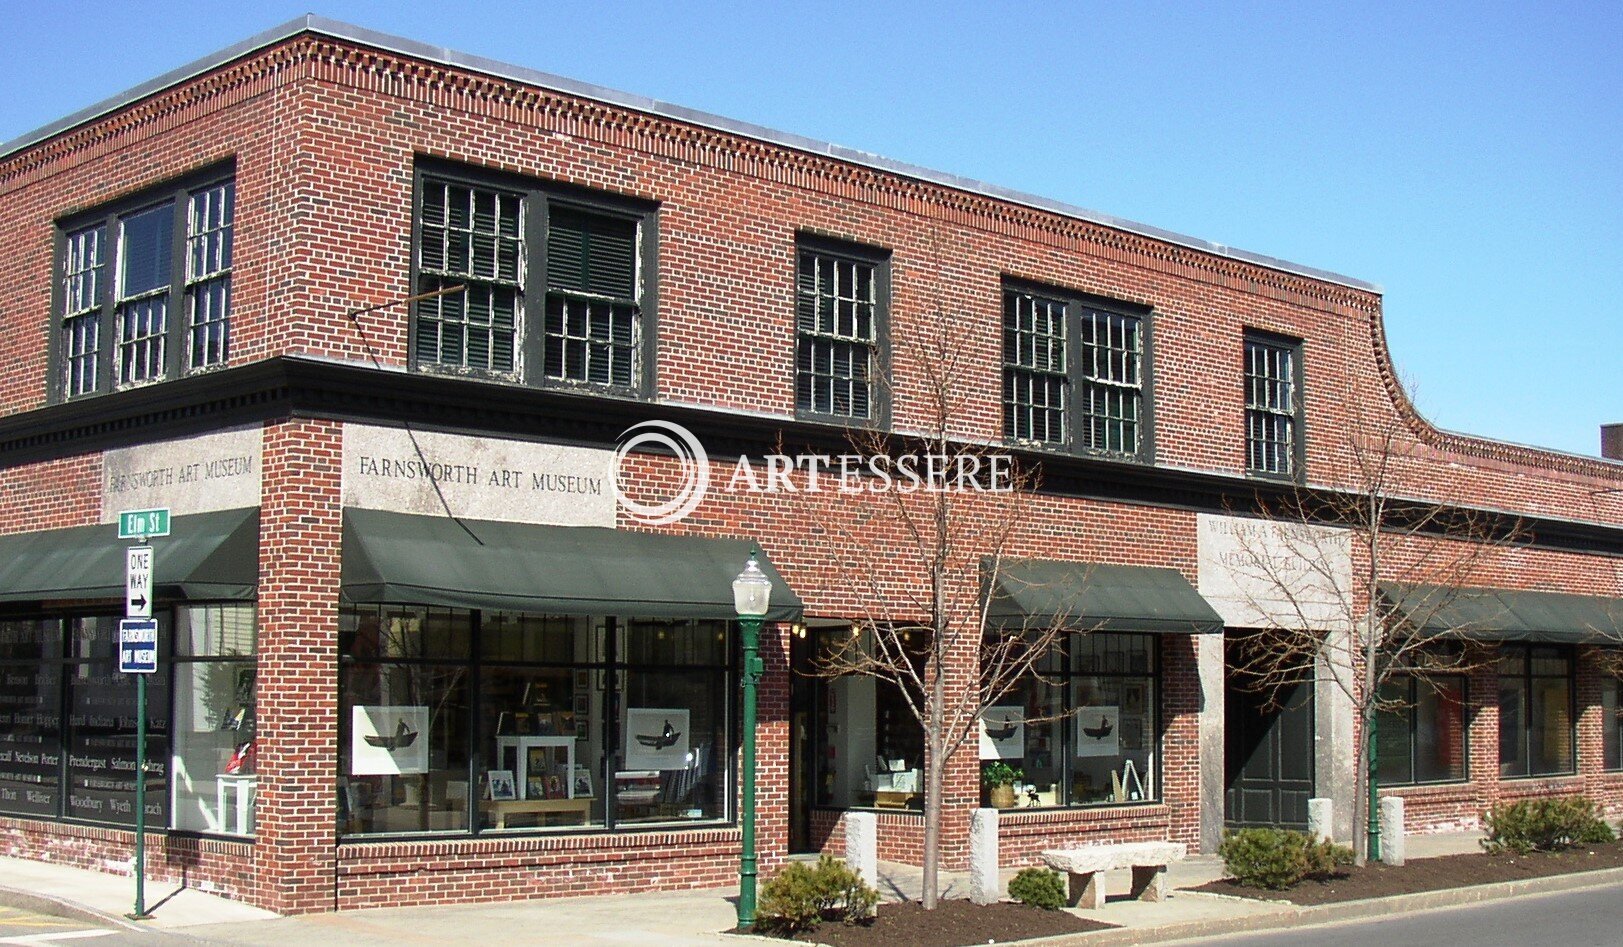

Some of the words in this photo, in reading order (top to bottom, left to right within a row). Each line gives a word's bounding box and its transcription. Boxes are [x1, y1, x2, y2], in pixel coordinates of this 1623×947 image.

[178, 464, 200, 484] ART
[204, 456, 252, 480] MUSEUM
[360, 456, 477, 485] FARNSWORTH
[488, 469, 522, 489] ART
[532, 473, 601, 496] MUSEUM
[127, 514, 146, 534] Elm
[149, 513, 160, 532] St
[130, 553, 149, 570] ONE
[130, 573, 148, 590] WAY
[69, 754, 106, 771] Prendergast
